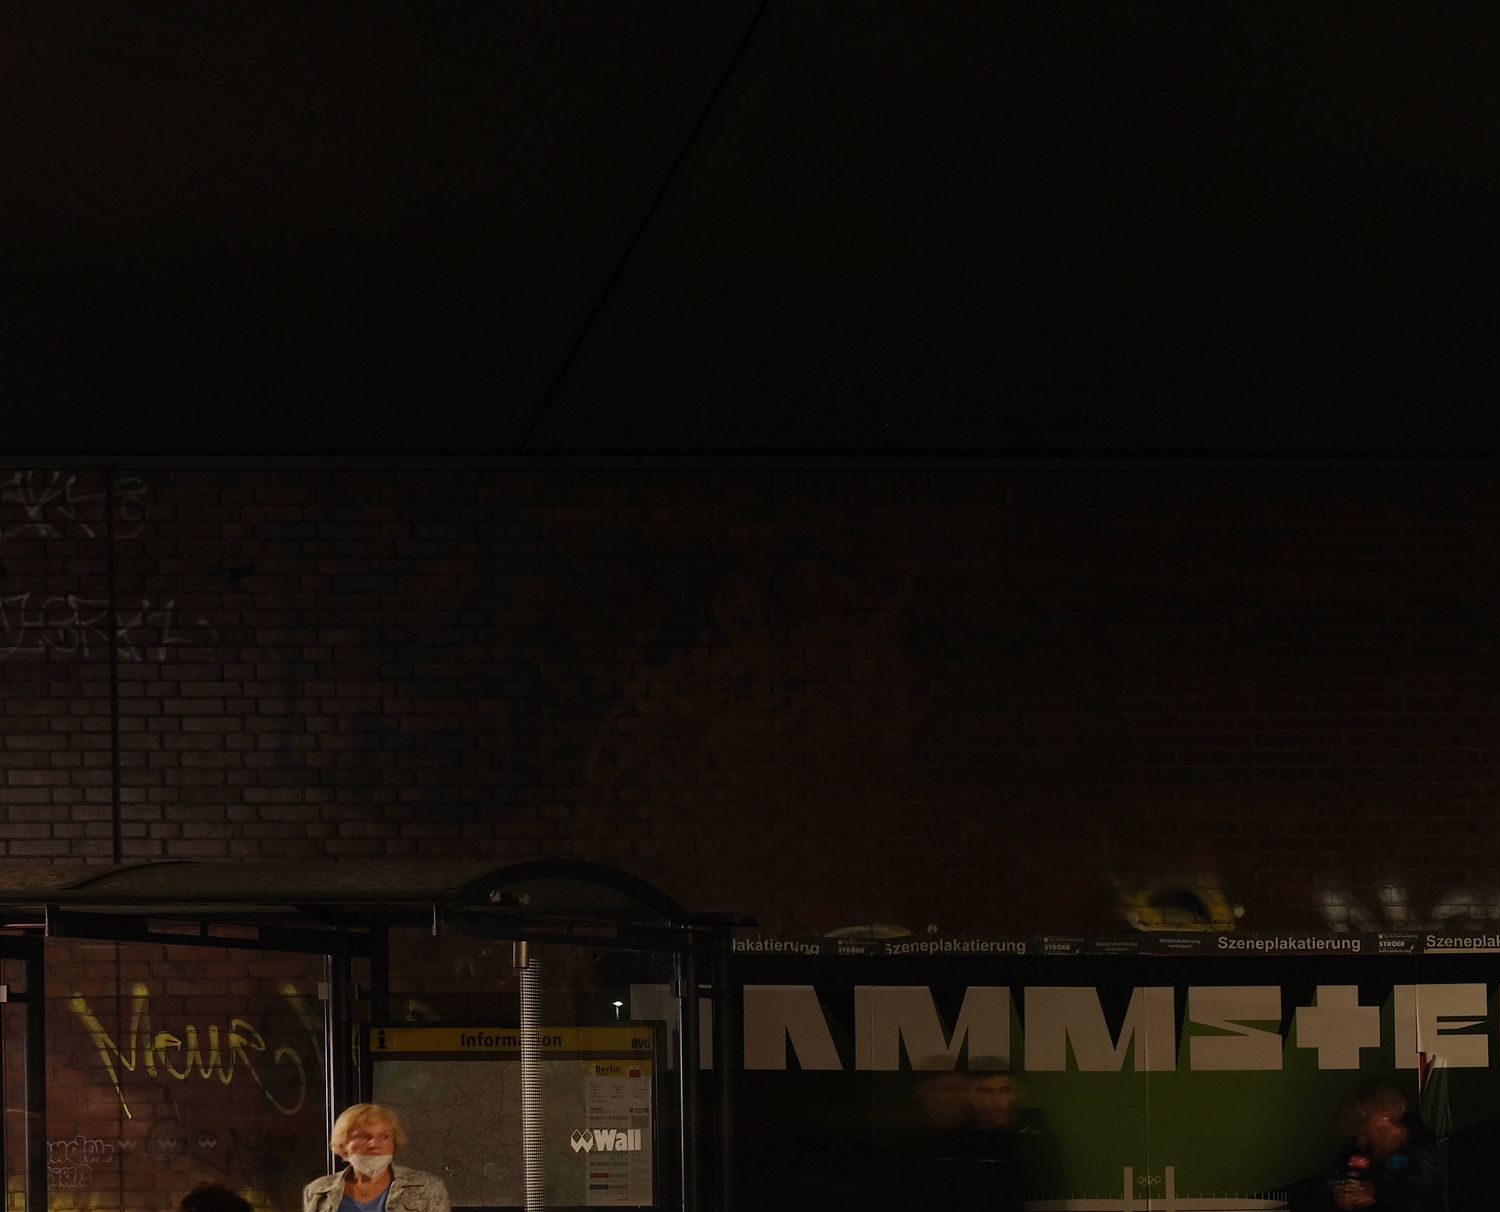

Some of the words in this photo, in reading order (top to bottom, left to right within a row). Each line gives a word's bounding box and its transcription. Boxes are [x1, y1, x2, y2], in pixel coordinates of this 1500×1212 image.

[1217, 936, 1361, 952] Szeneplakatierung
[461, 1033, 561, 1047] Informon
[632, 1039, 650, 1048] BVG
[595, 1065, 620, 1074] Berlin
[594, 1129, 641, 1151] Wall
